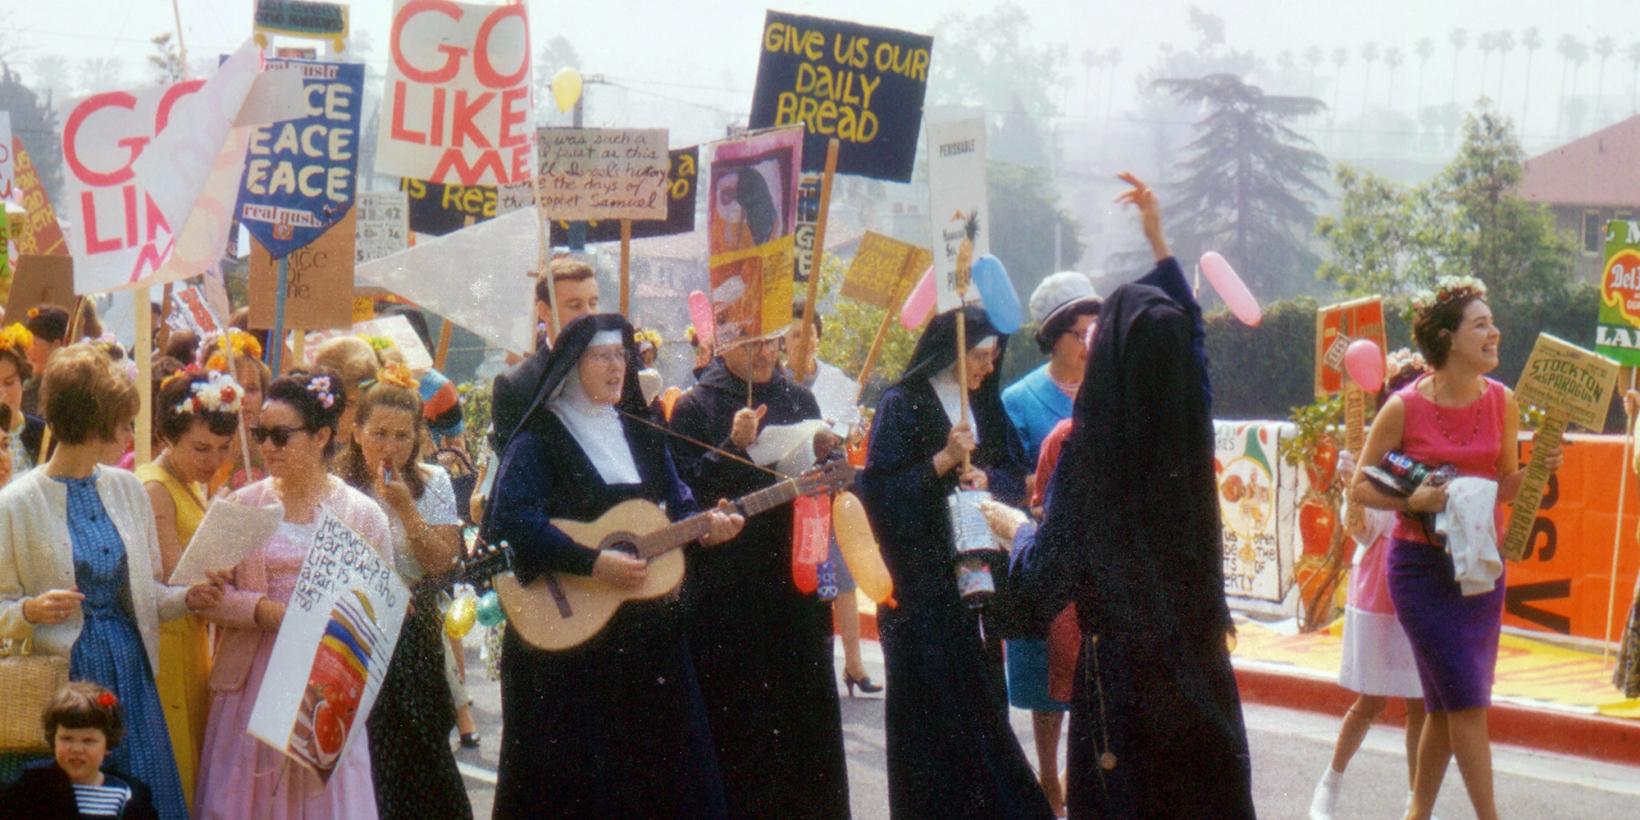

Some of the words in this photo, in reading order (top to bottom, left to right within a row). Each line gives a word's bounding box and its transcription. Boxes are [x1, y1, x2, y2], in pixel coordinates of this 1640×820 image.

[391, 0, 531, 89] GO
[834, 33, 869, 69] US
[875, 42, 930, 82] OUR
[391, 80, 530, 149] LIKE
[250, 123, 354, 161] EACE
[594, 131, 631, 145] such
[626, 145, 661, 159] this
[247, 158, 350, 203] EACE
[429, 144, 532, 187] ME
[81, 184, 173, 256] LI
[590, 191, 657, 209] Samuel
[1529, 358, 1604, 404] STOCKTON
